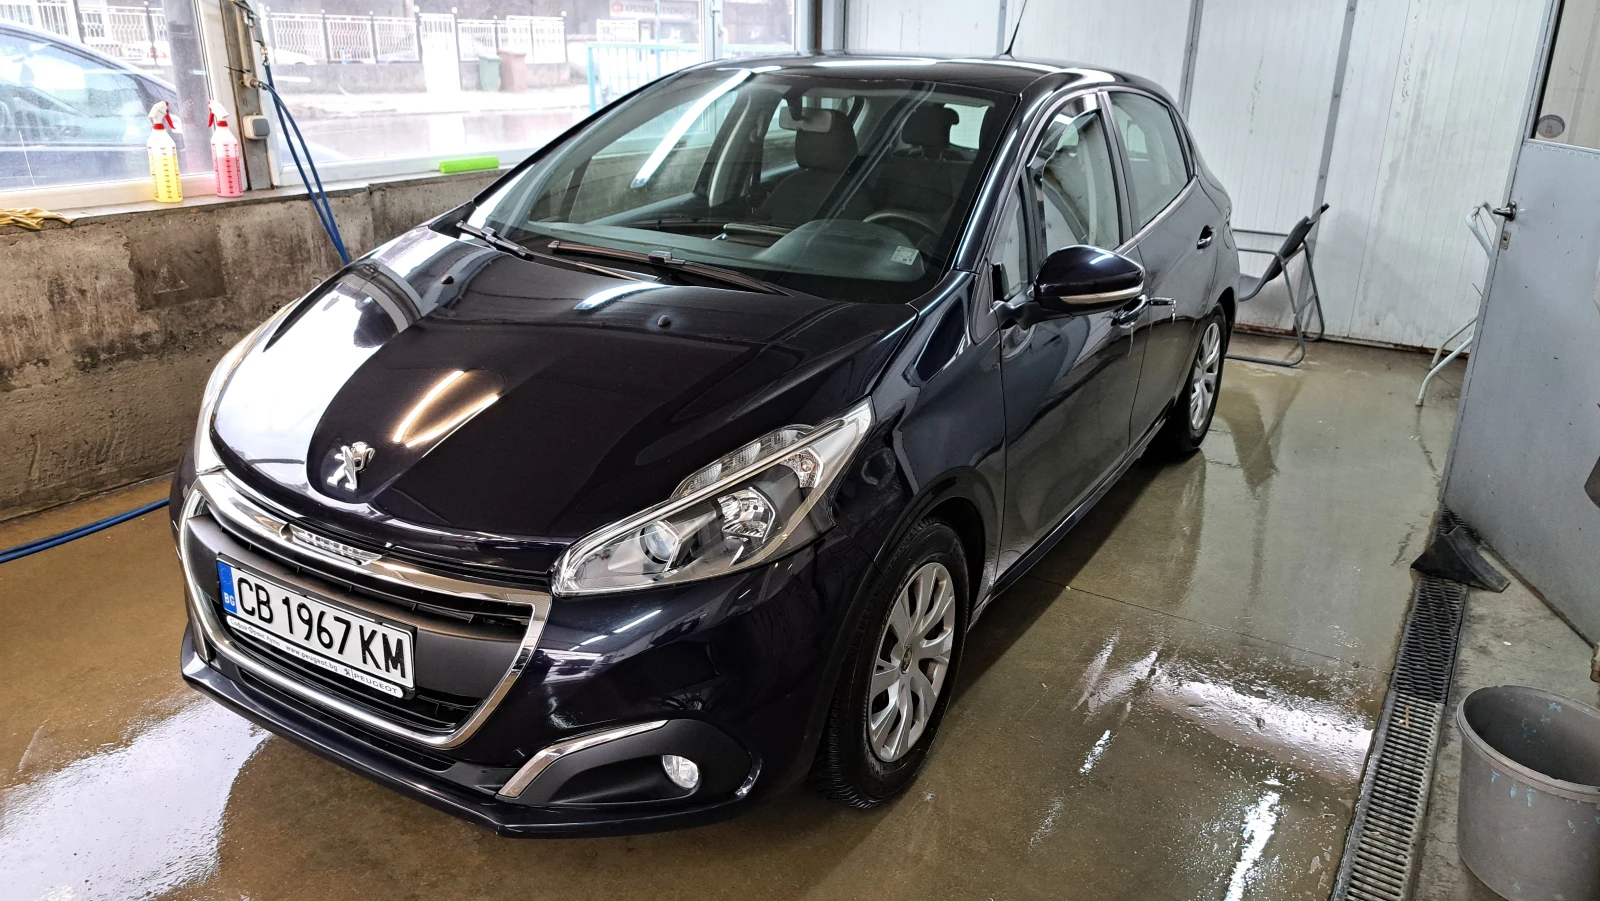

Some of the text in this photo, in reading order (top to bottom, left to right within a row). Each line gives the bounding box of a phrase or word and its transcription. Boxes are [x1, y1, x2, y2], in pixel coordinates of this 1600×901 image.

[224, 592, 235, 606] BG
[237, 577, 406, 679] CB 1967 KM
[286, 646, 397, 694] www.peugeot.bg PEUGEOT
